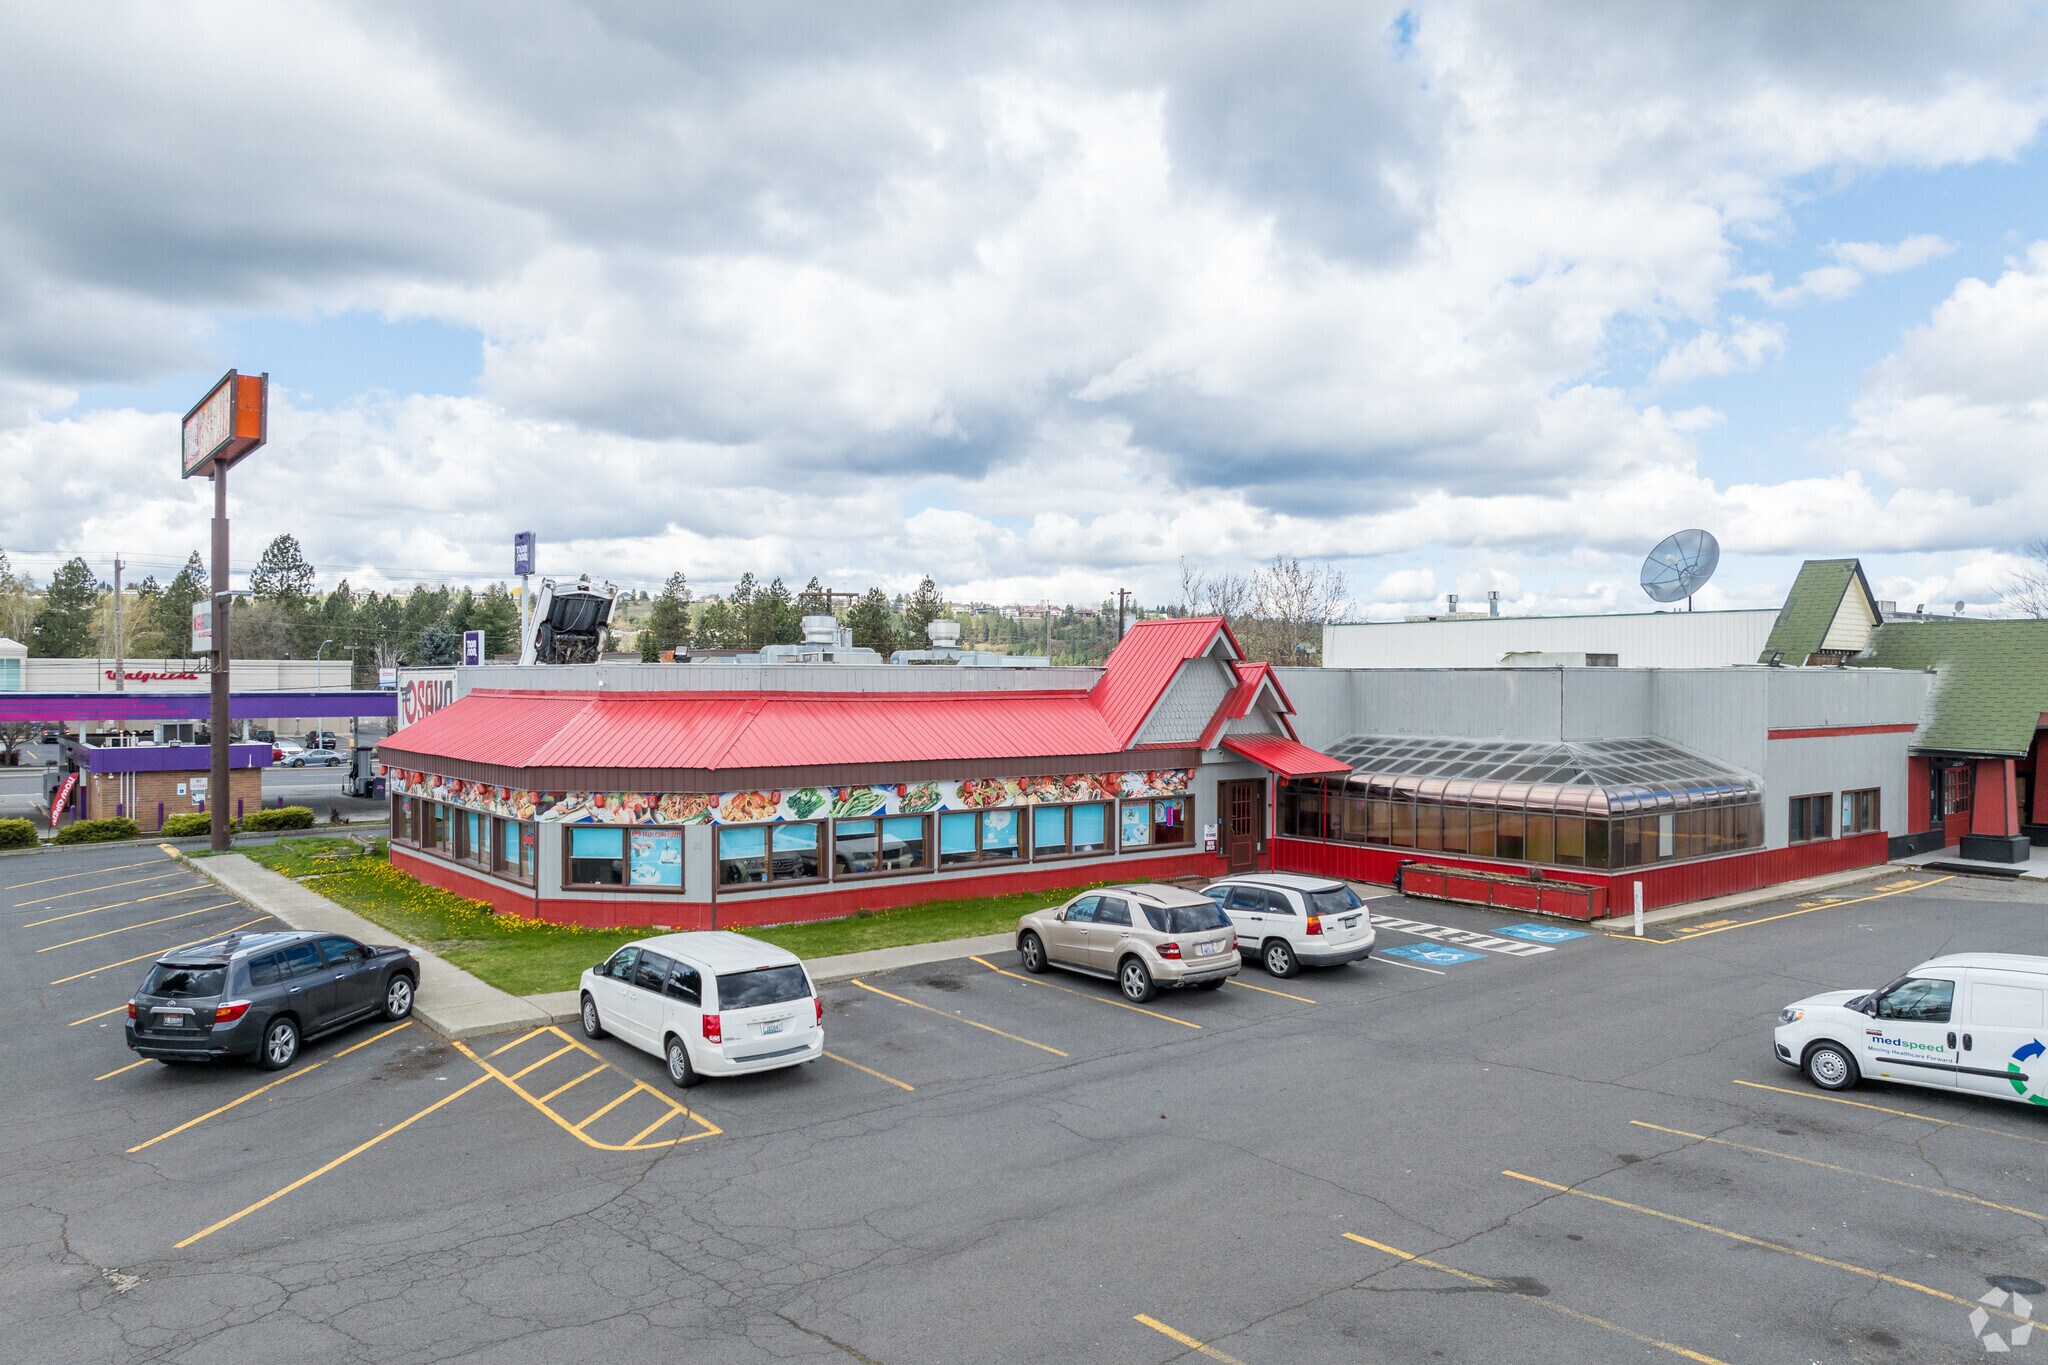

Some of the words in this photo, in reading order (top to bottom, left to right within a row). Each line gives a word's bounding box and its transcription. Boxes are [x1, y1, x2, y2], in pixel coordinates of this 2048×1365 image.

[105, 670, 198, 683] Walgreens
[1872, 1035, 1945, 1053] medspeed
[1867, 1045, 1890, 1055] Moving
[1891, 1048, 1926, 1060] Healthcare
[1926, 1054, 1954, 1064] Forward
